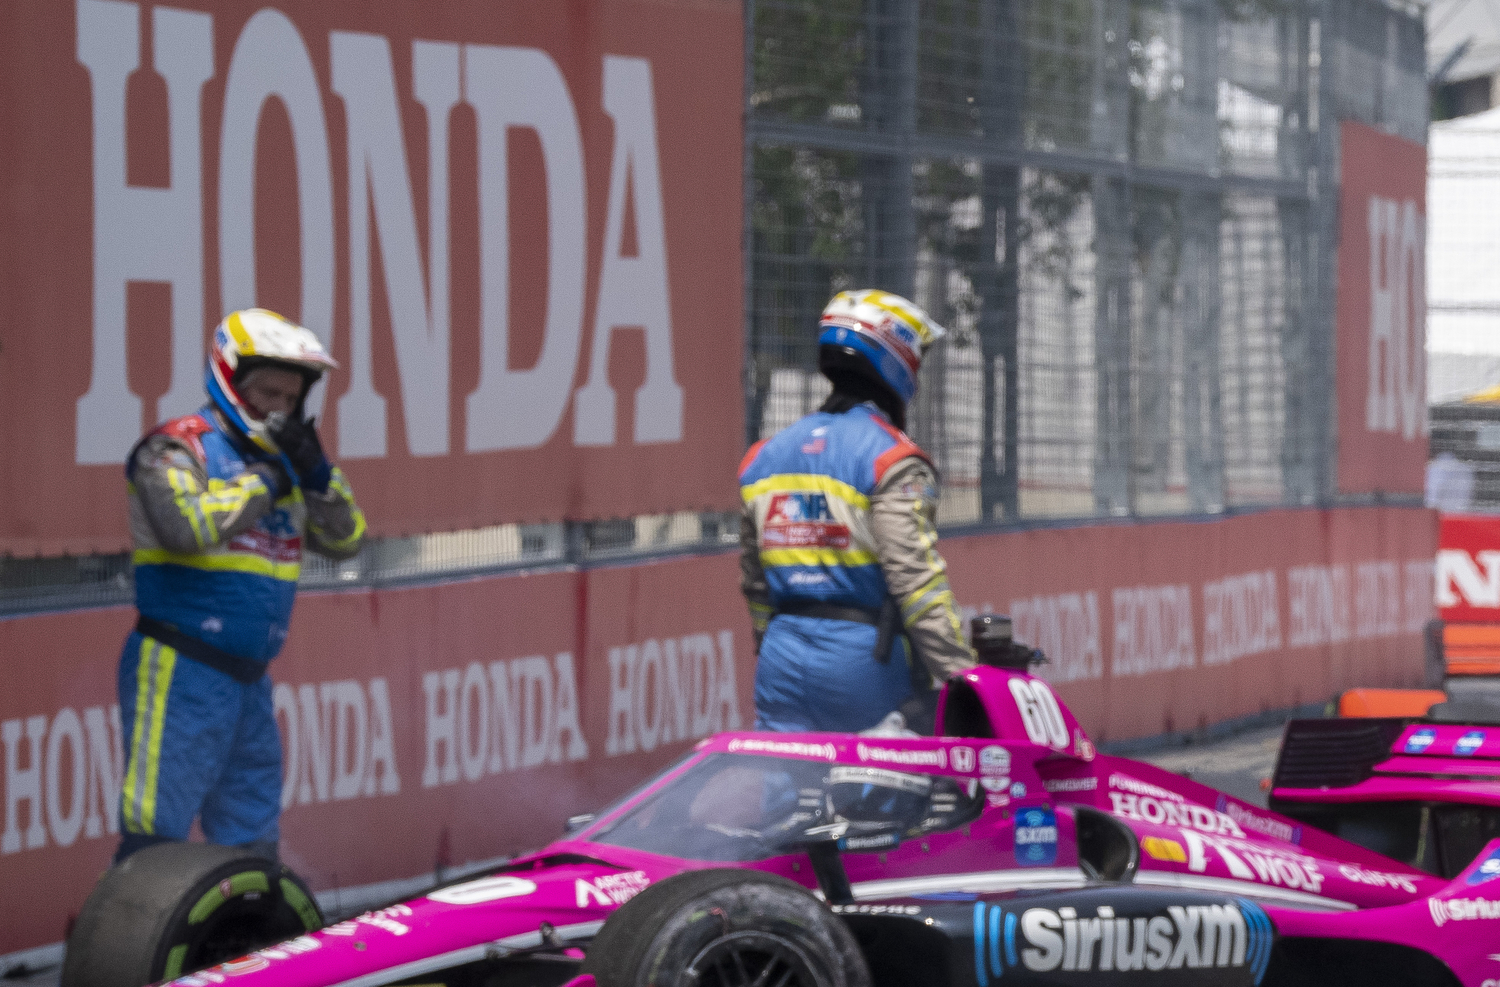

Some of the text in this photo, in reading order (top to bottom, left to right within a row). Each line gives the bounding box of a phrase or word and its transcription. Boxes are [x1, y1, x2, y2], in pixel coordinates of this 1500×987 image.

[76, 0, 684, 464] HONDA
[423, 653, 587, 788] HONDA
[606, 631, 741, 757] HONDA
[1008, 678, 1070, 749] 60
[1108, 792, 1246, 839] HONDA
[1242, 852, 1325, 893] WOLF
